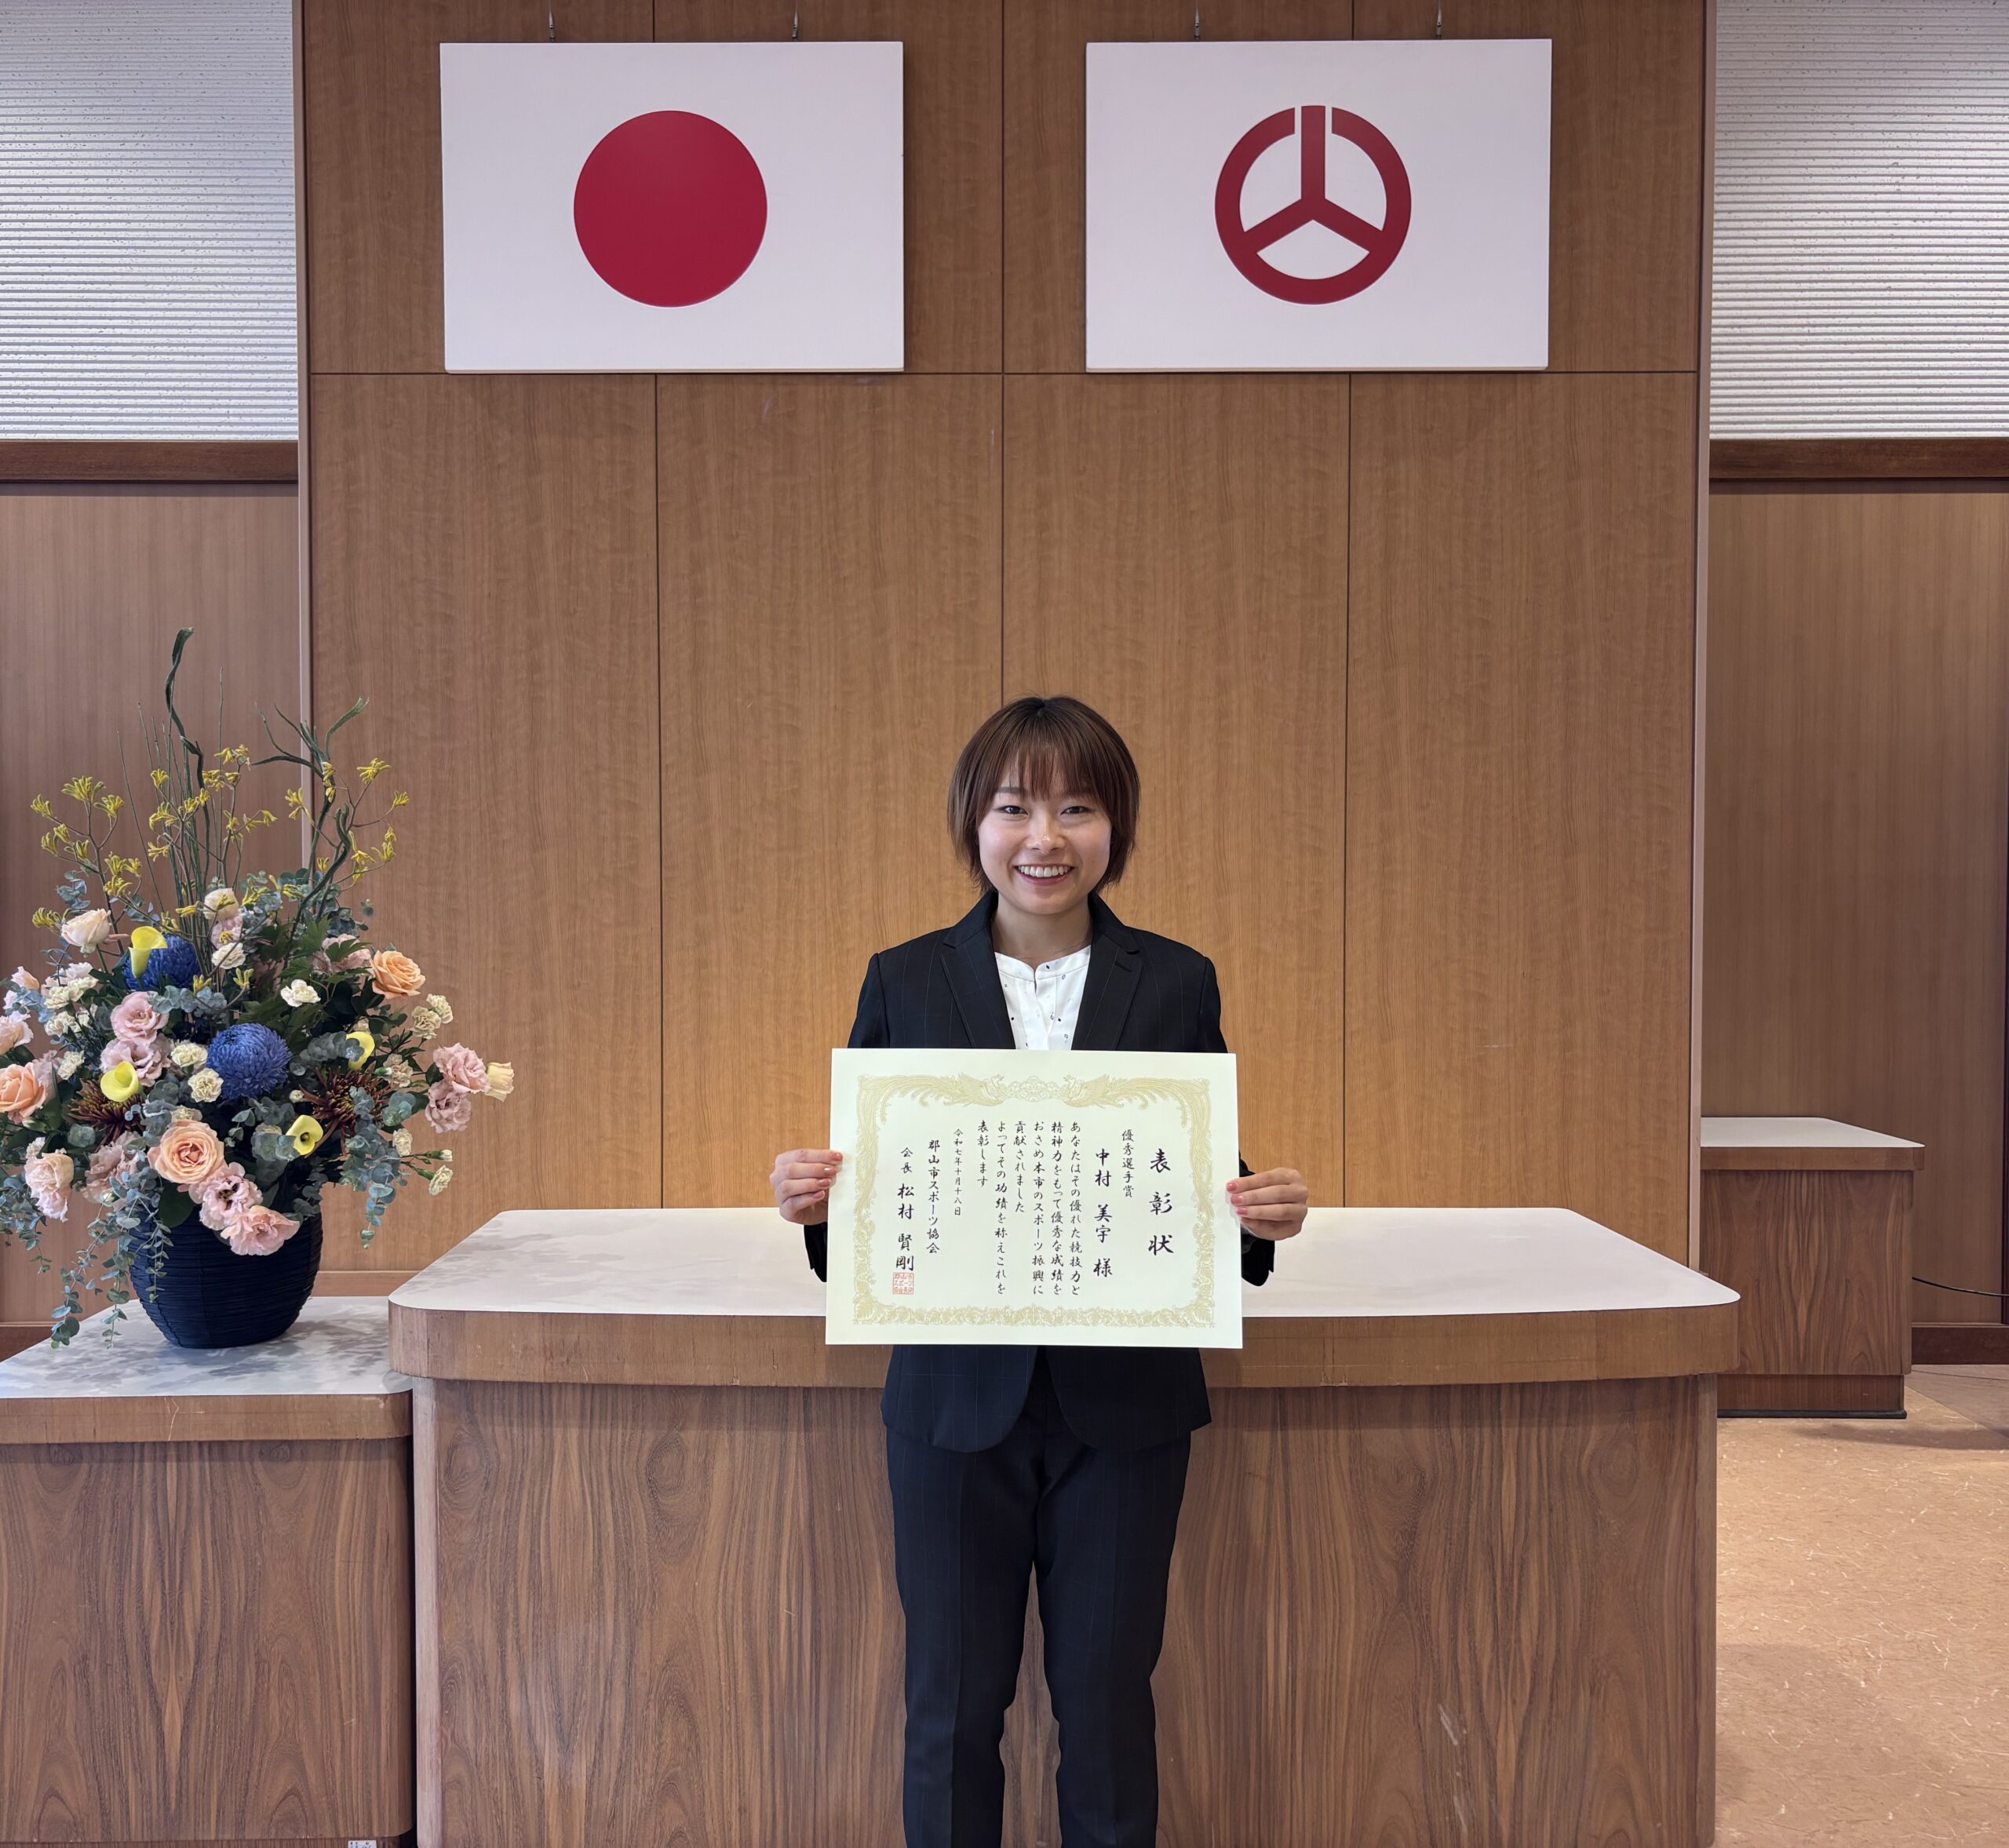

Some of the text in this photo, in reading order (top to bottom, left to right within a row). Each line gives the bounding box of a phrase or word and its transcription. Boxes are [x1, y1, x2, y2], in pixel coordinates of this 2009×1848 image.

[895, 1146, 915, 1271] 会長 松村 賢剛
[926, 1139, 942, 1254] 郡山市スポーツ協会
[953, 1128, 964, 1216] 令和七年十月十八日
[977, 1120, 990, 1187] 表彰します
[994, 1121, 1008, 1295] よってその功績を称えこれを
[1013, 1121, 1026, 1212] 貢献されました
[1031, 1121, 1045, 1295] おさめ本市のスポーツ振興に
[1051, 1121, 1064, 1296] 精神力をもって優秀な成績を
[1069, 1121, 1083, 1296] あなたはその優れた競技力と
[1092, 1148, 1113, 1278] 中村 美宇 様
[1121, 1128, 1135, 1198] 優秀選手賞
[1147, 1148, 1174, 1256] 表彰状
